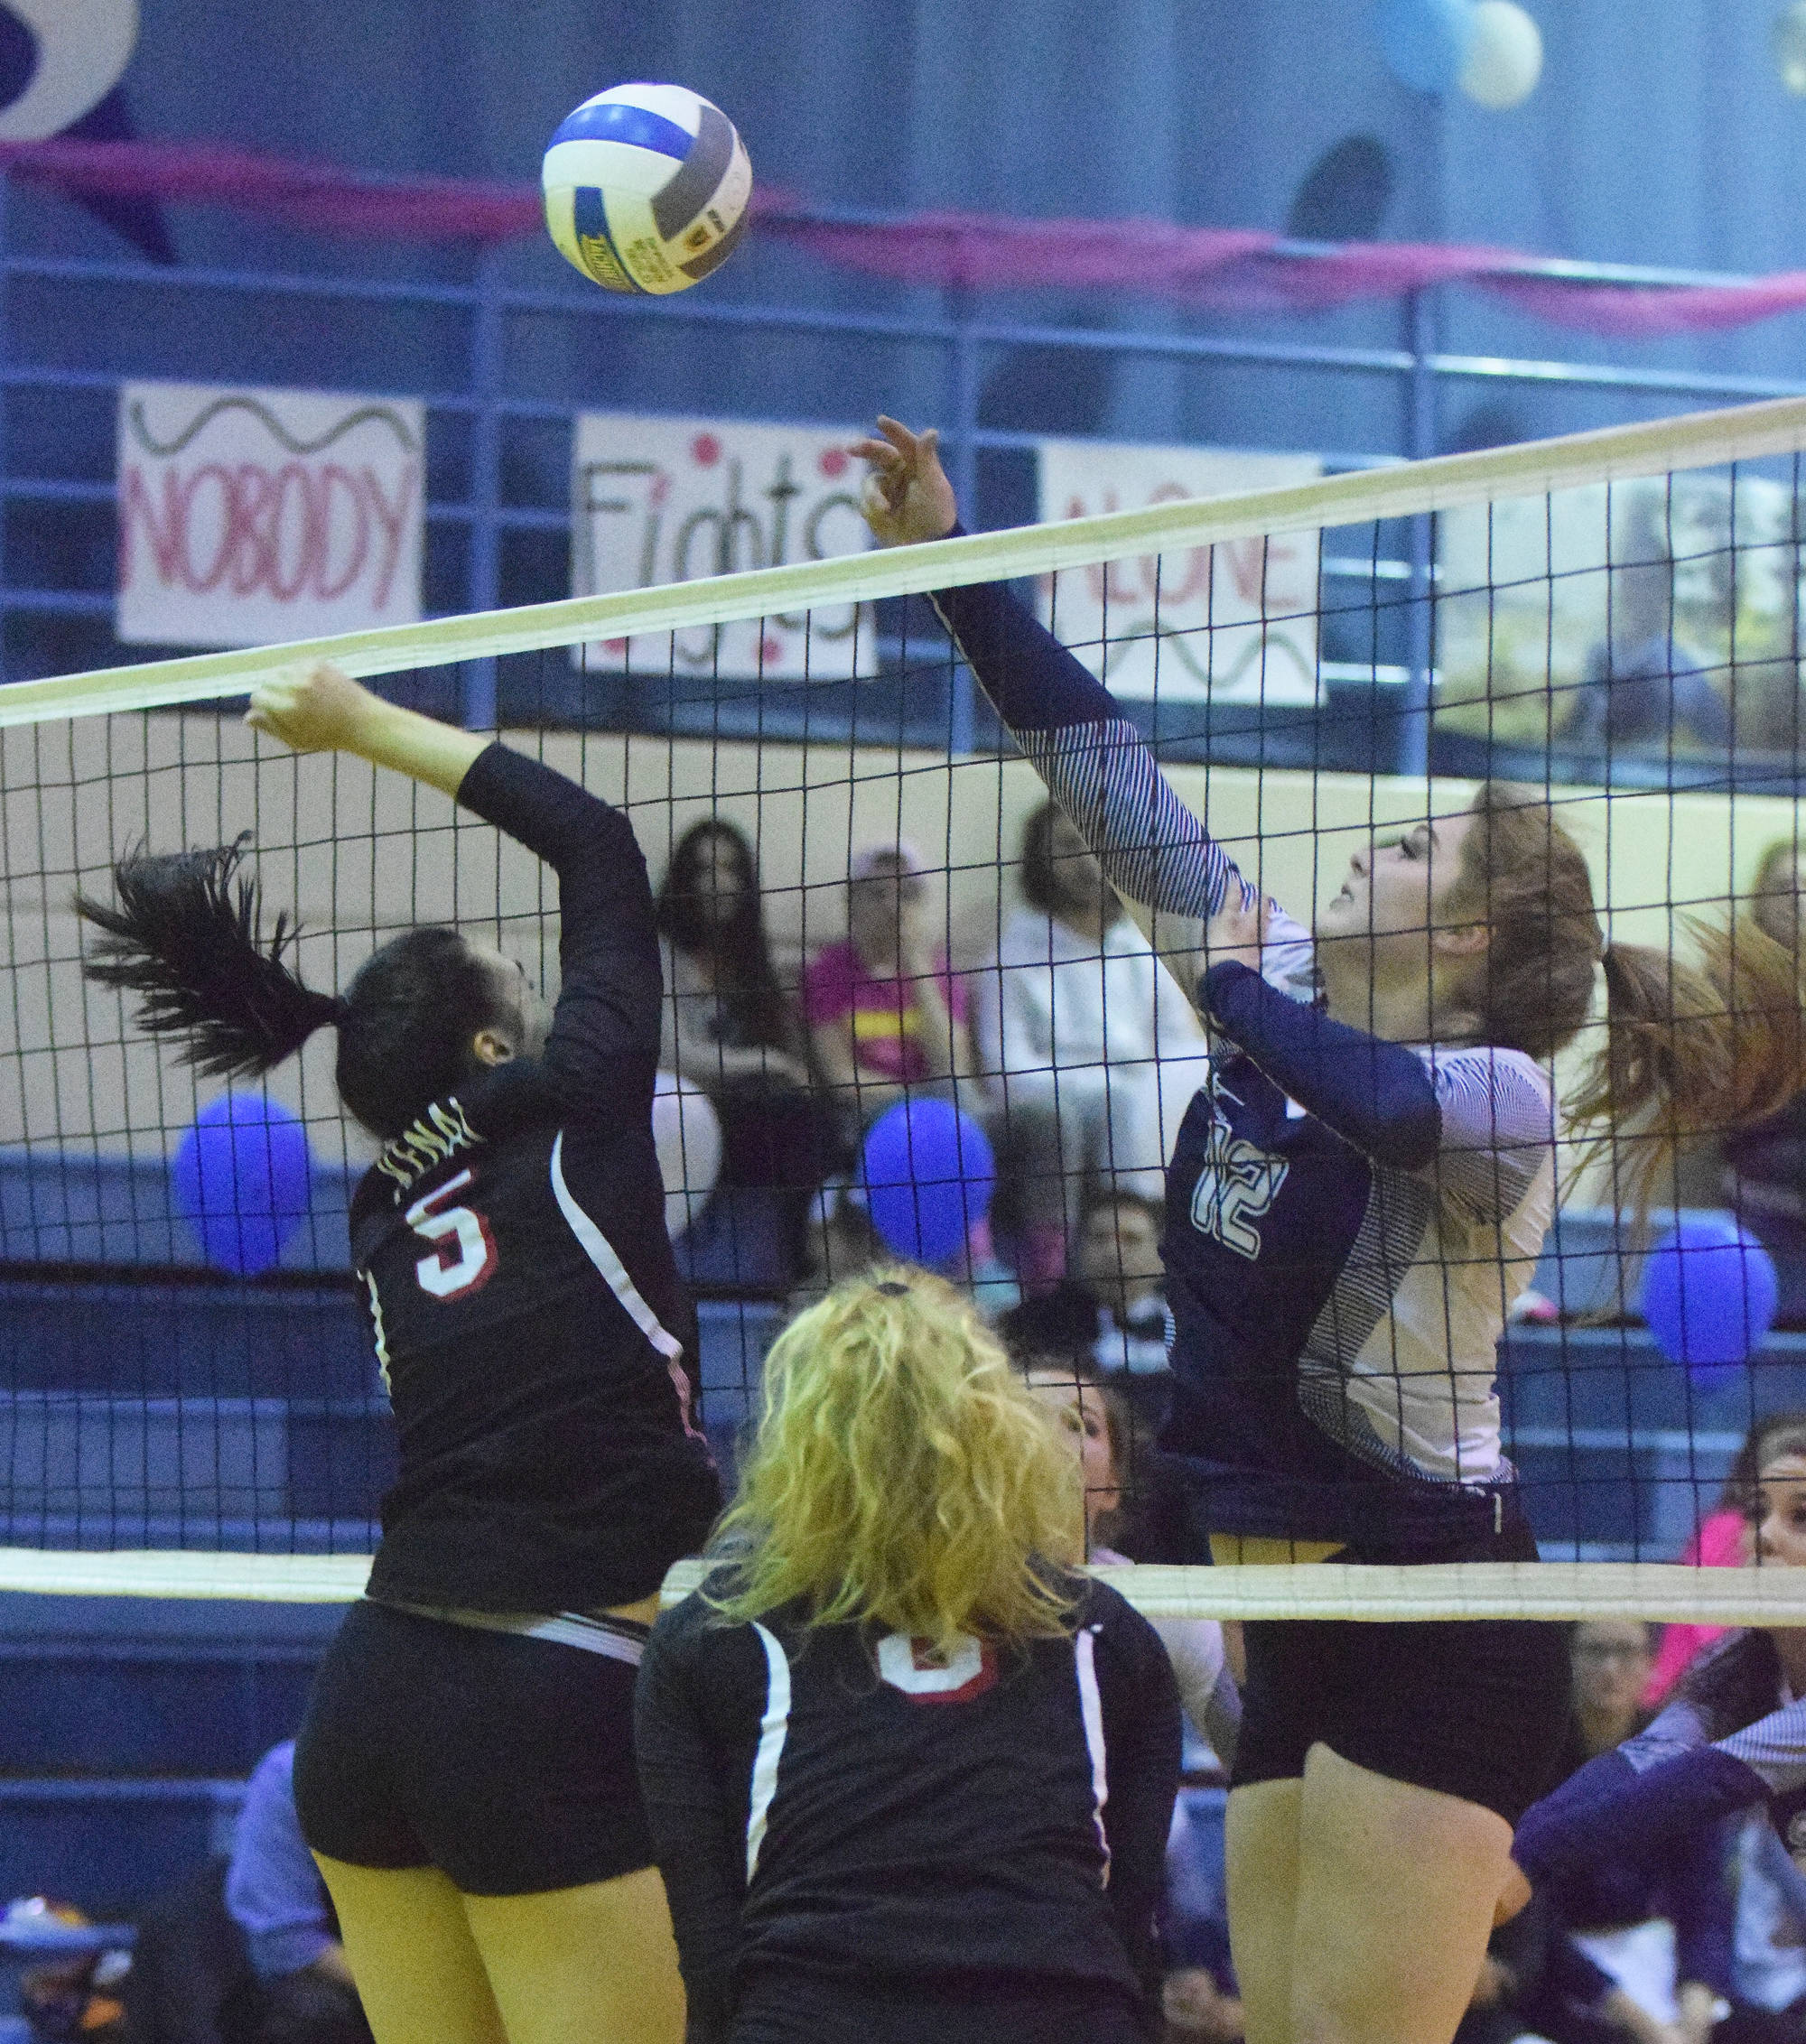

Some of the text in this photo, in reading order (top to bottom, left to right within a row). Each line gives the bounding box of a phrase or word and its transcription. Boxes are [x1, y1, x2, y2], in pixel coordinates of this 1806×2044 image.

[121, 460, 421, 610] NOBODY
[405, 1167, 500, 1300] 5
[1191, 1120, 1290, 1261] 12
